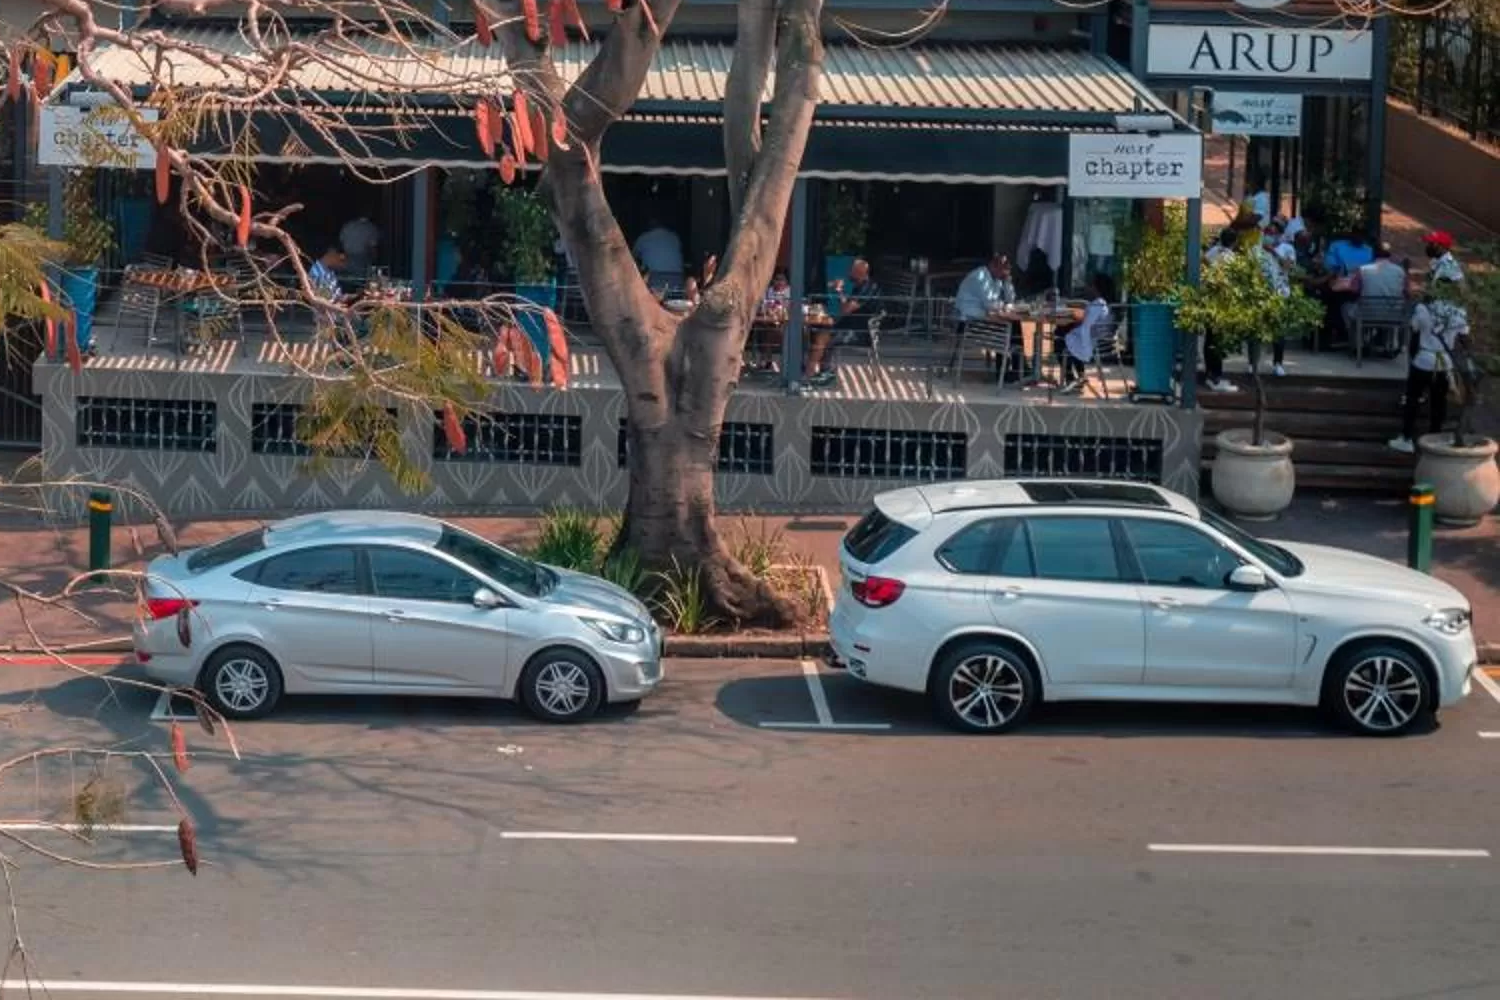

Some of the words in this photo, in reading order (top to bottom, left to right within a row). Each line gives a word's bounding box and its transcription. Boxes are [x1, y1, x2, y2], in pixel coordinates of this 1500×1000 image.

[1189, 30, 1333, 73] ARUP
[53, 129, 139, 149] chater
[1085, 157, 1183, 180] chapter
